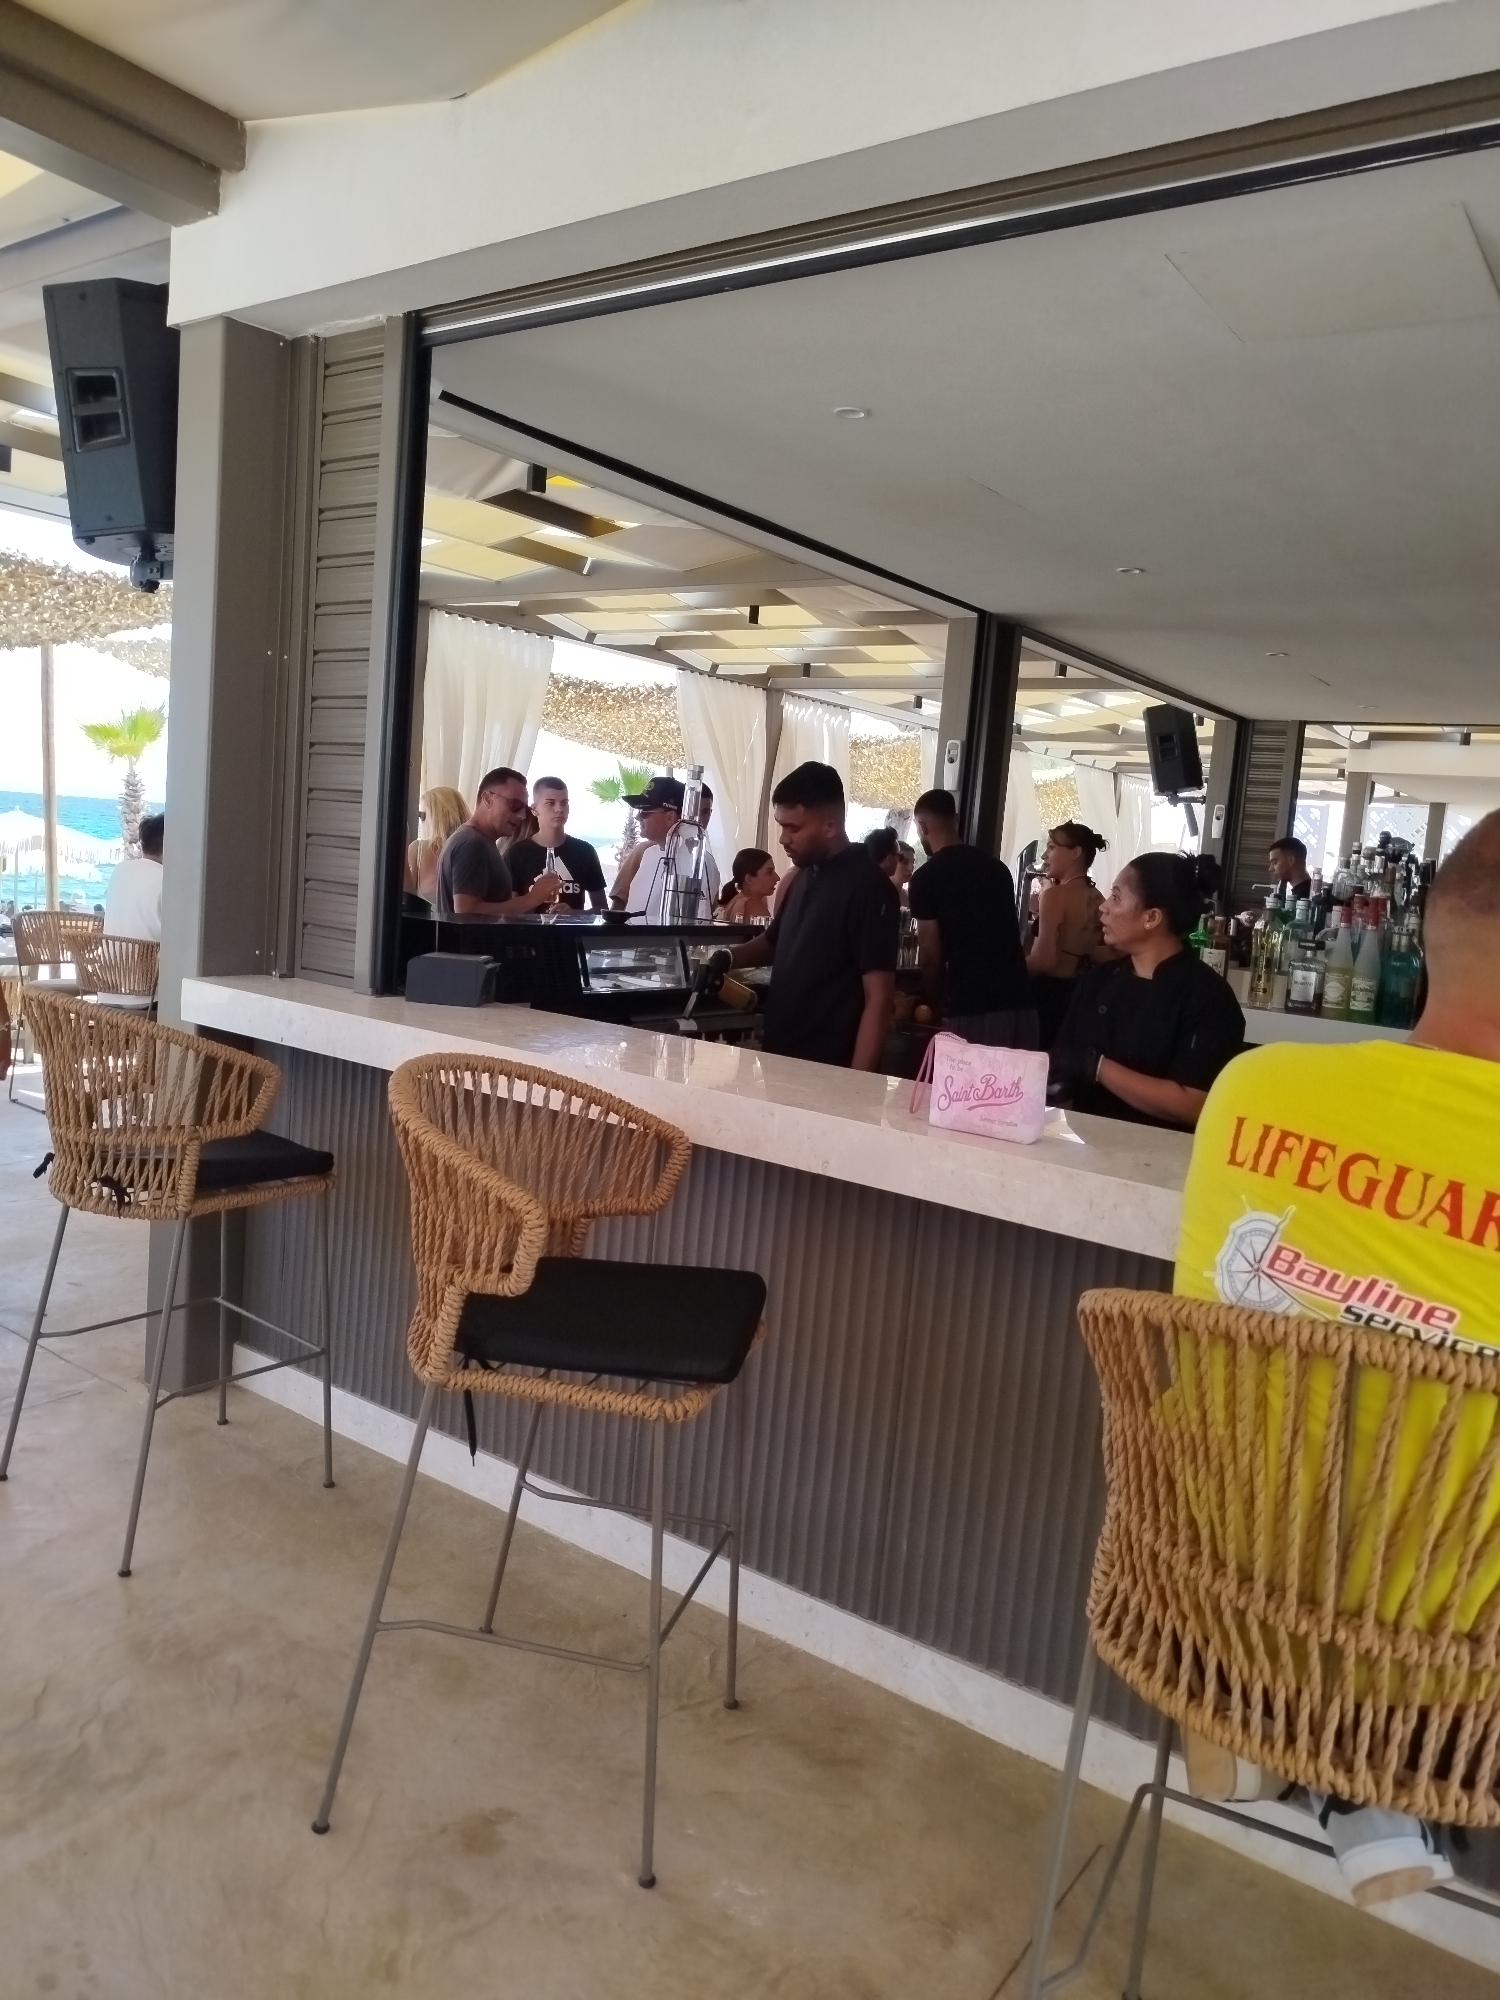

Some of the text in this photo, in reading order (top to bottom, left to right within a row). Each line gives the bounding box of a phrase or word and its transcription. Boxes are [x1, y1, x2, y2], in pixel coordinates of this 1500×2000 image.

[946, 1055, 972, 1067] The place
[937, 1074, 1023, 1111] Saint Barth
[1266, 1245, 1457, 1329] Bayline
